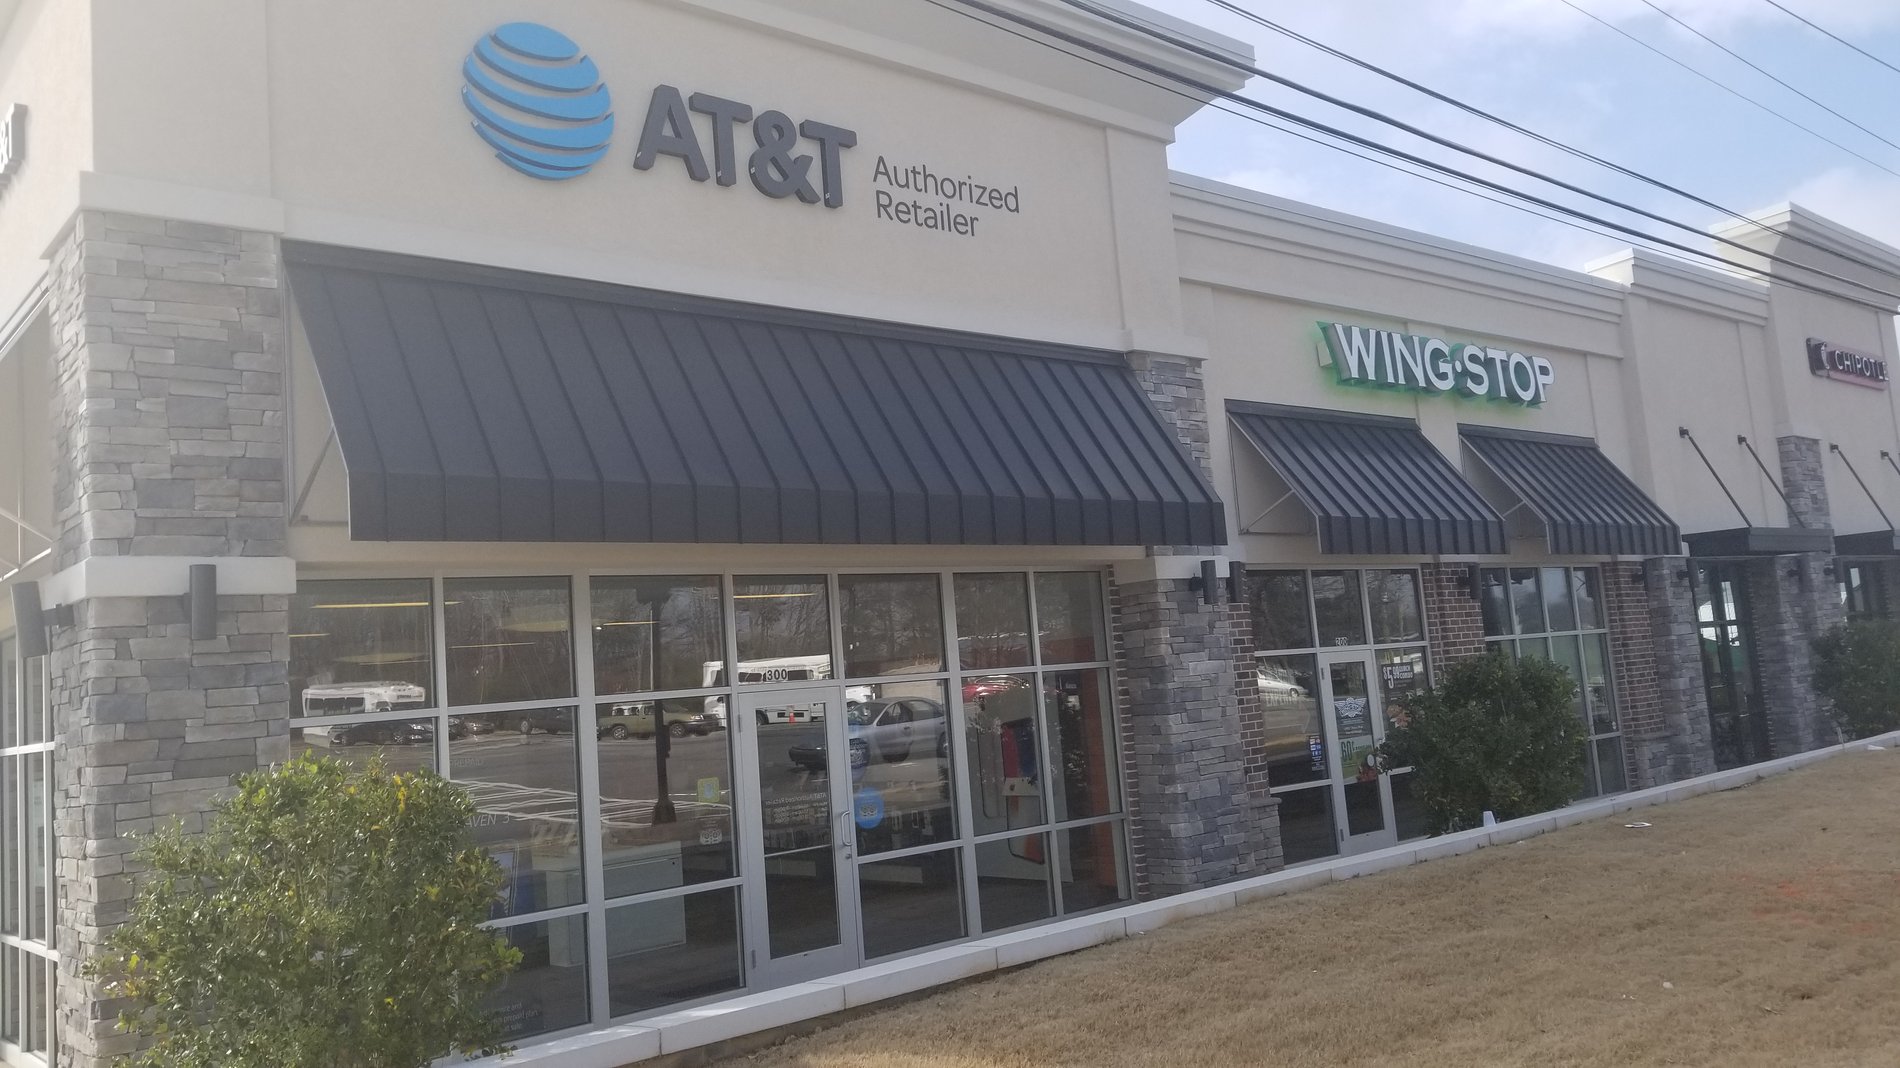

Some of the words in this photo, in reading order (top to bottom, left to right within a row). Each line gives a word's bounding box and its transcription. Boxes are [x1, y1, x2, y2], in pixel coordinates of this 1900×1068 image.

[633, 84, 857, 209] AT&T
[872, 155, 1020, 214] Authorized
[875, 189, 979, 237] Retailer
[1835, 350, 1889, 380] CHIPOTLE
[767, 669, 787, 680] 300
[463, 813, 497, 828] AVEN
